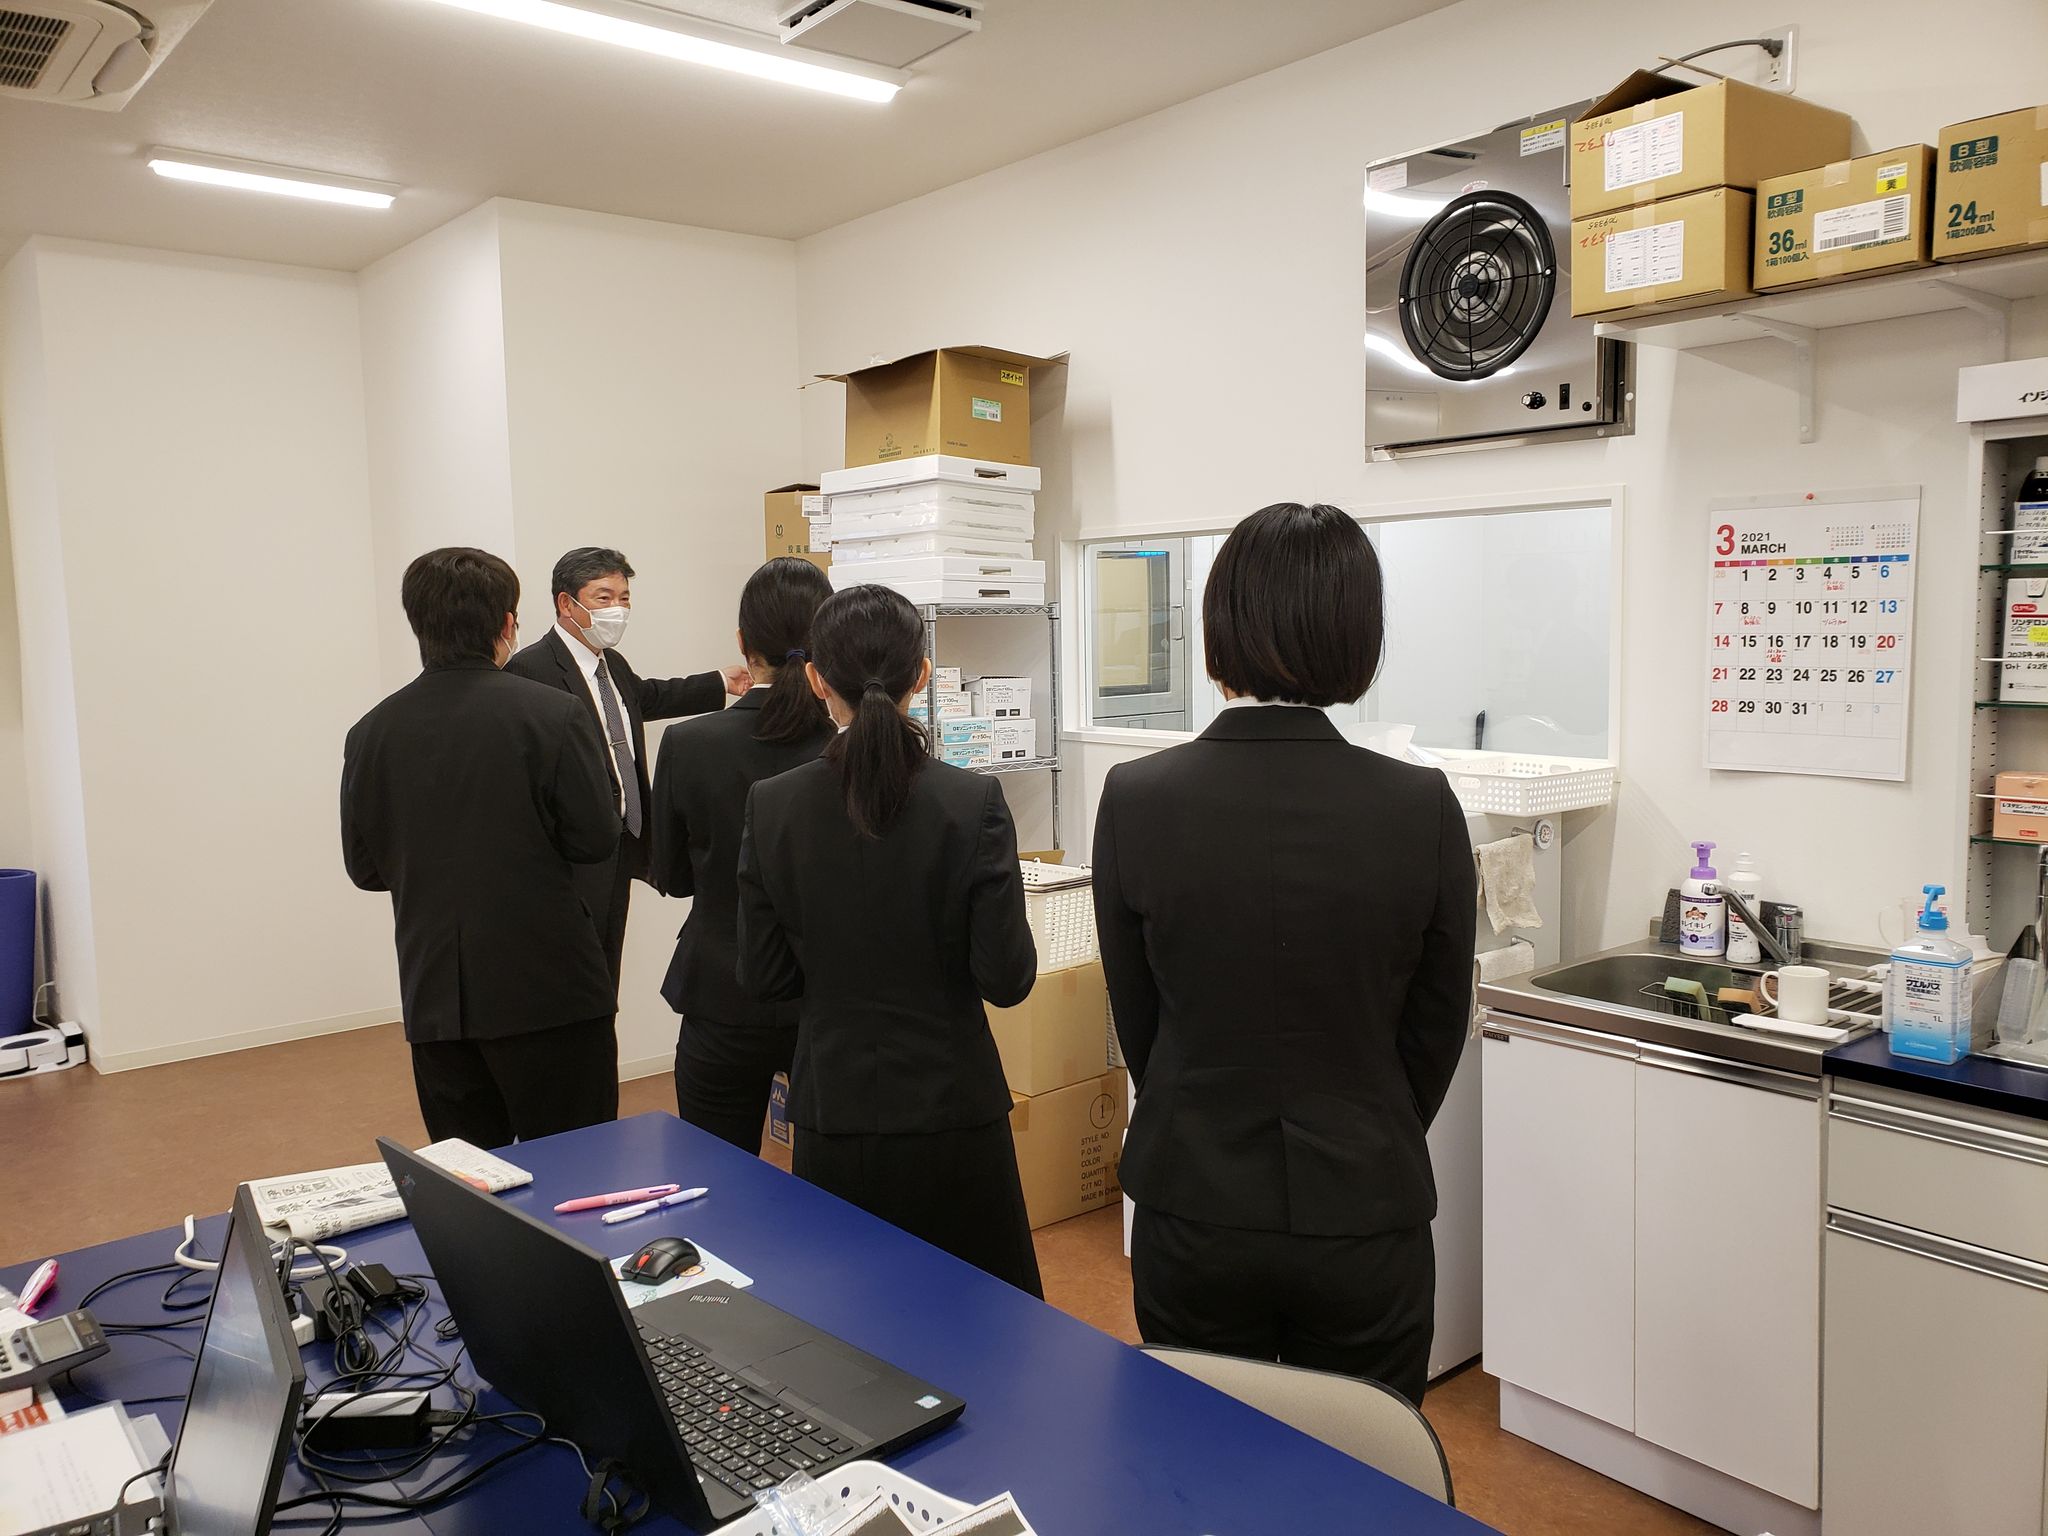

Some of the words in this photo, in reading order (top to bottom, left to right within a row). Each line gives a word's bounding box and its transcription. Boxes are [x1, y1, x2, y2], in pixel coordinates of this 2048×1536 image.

[1716, 524, 1735, 555] 3
[1741, 532, 1770, 542] 2021
[1741, 543, 1786, 554] MARCH
[1742, 569, 1748, 581] 1
[1768, 568, 1777, 581] 2
[1796, 567, 1805, 580] 3
[1823, 567, 1832, 580] 4
[1851, 566, 1860, 579] 5
[1881, 565, 1889, 578] 6
[1714, 602, 1723, 615] 7
[1741, 602, 1749, 615] 8
[1768, 602, 1776, 614] 9
[1795, 601, 1812, 614] 10
[1823, 601, 1838, 613] 11
[1851, 600, 1868, 613] 12
[1879, 600, 1897, 613] 13
[1714, 635, 1730, 647] 14
[1741, 635, 1757, 648] 15
[1767, 635, 1784, 648] 16
[1795, 635, 1811, 648] 17
[1822, 635, 1839, 648] 18
[1849, 635, 1866, 648] 19
[1877, 635, 1896, 648] 20
[1712, 667, 1728, 680] 21
[1739, 668, 1756, 680] 22
[1766, 668, 1783, 681] 23
[1793, 669, 1810, 681] 24
[1820, 669, 1837, 682] 25
[1847, 670, 1865, 683] 26
[1875, 670, 1894, 683] 27
[1711, 700, 1728, 712] 28
[1738, 700, 1755, 713] 29
[1765, 701, 1782, 714] 30
[1792, 702, 1807, 715] 31
[1819, 703, 1824, 711] 1
[1846, 704, 1852, 712] 2
[1081, 1134, 1099, 1146] STYLE
[1081, 1191, 1097, 1202] MADE
[688, 1294, 730, 1304] ThinkPad
